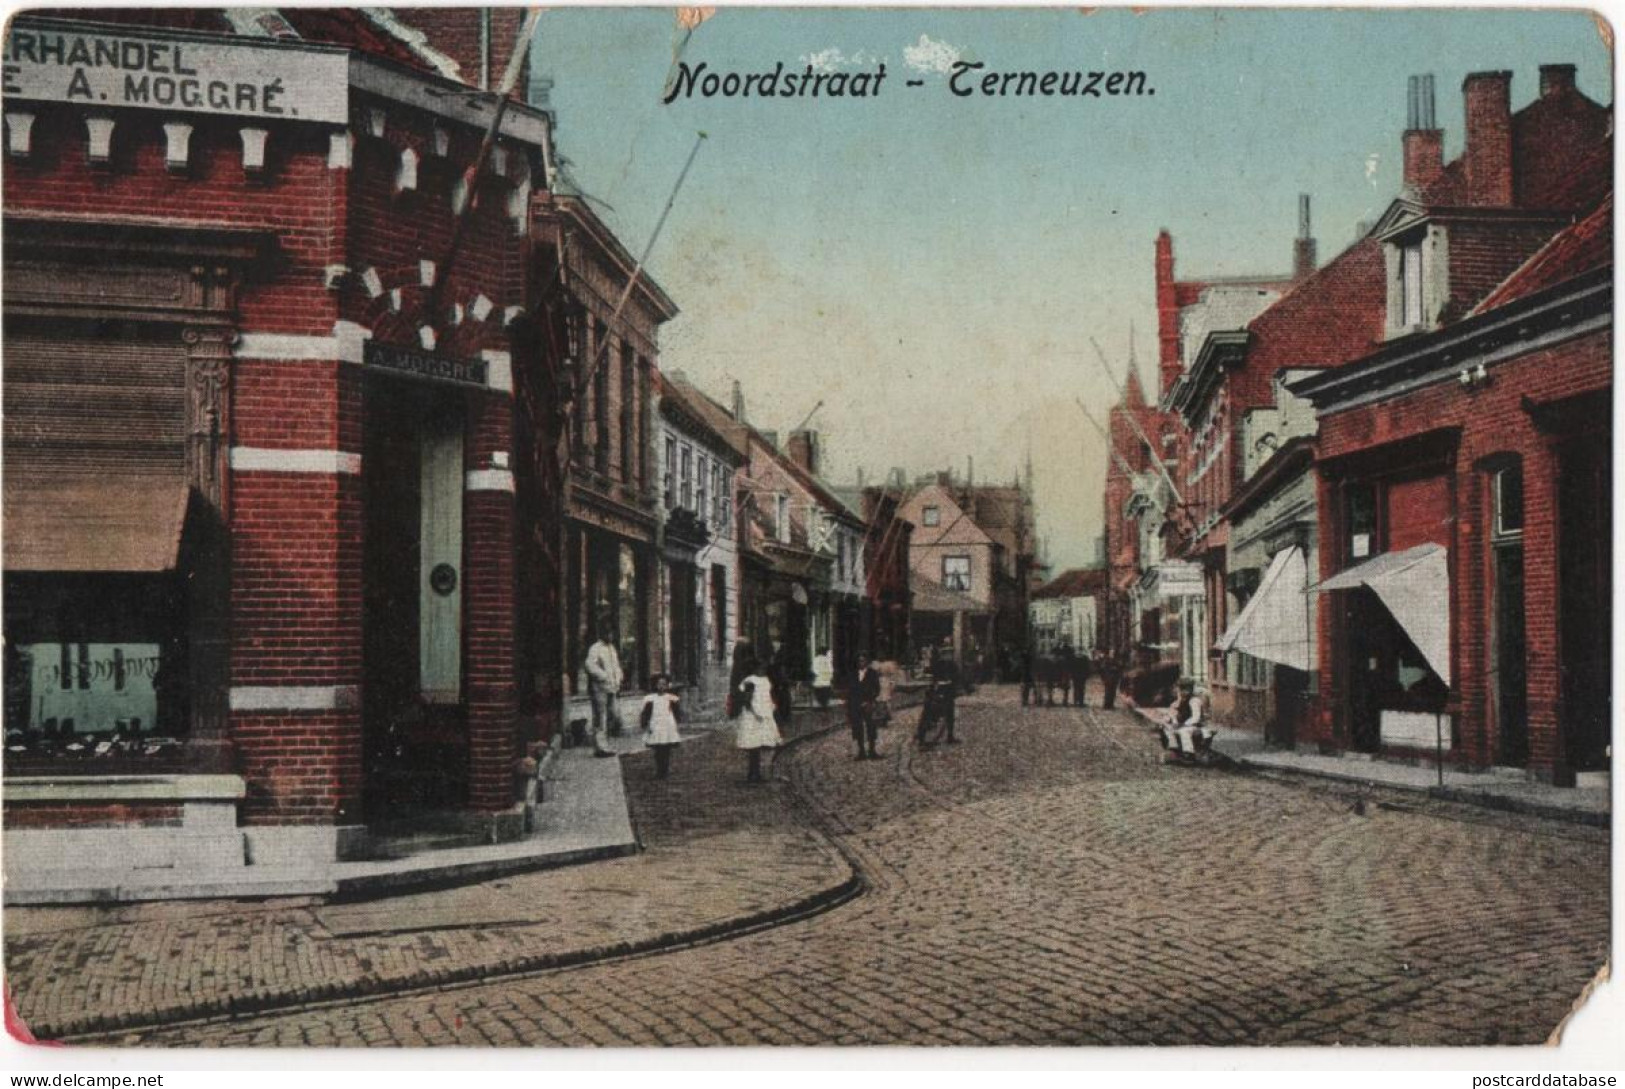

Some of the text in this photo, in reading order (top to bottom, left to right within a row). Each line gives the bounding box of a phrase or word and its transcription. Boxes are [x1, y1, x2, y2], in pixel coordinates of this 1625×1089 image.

[3, 32, 196, 75] RHANDEL
[67, 68, 107, 100] A.
[124, 75, 298, 115] MOGGRÉ.
